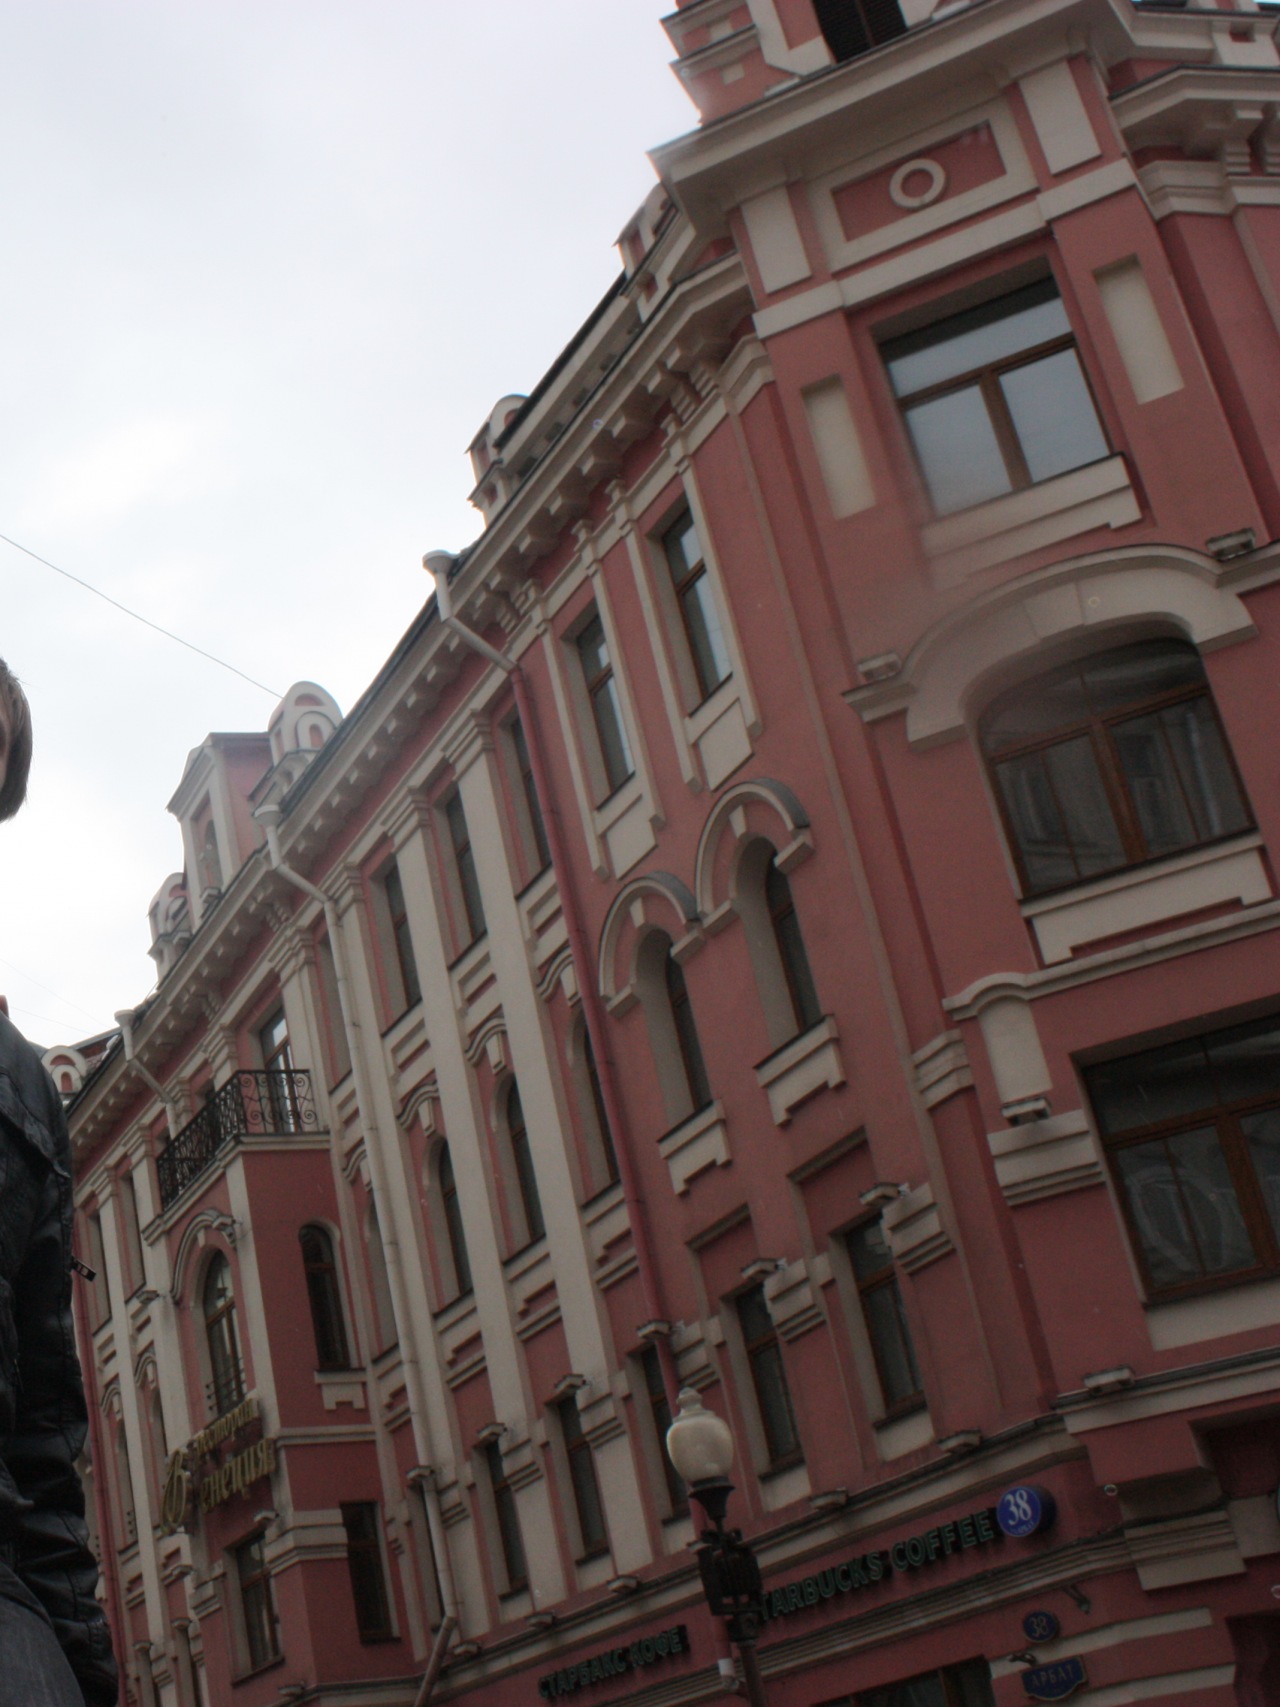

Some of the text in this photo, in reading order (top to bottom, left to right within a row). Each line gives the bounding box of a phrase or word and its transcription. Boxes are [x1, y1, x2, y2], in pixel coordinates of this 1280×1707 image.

[1004, 1489, 1032, 1526] 38
[760, 1510, 994, 1620] TARBUCKS COFFEE
[1028, 1615, 1048, 1638] 38
[538, 1625, 685, 1699] СТАРБАКС КОФЕ
[1031, 1663, 1075, 1689] АРБАТ
